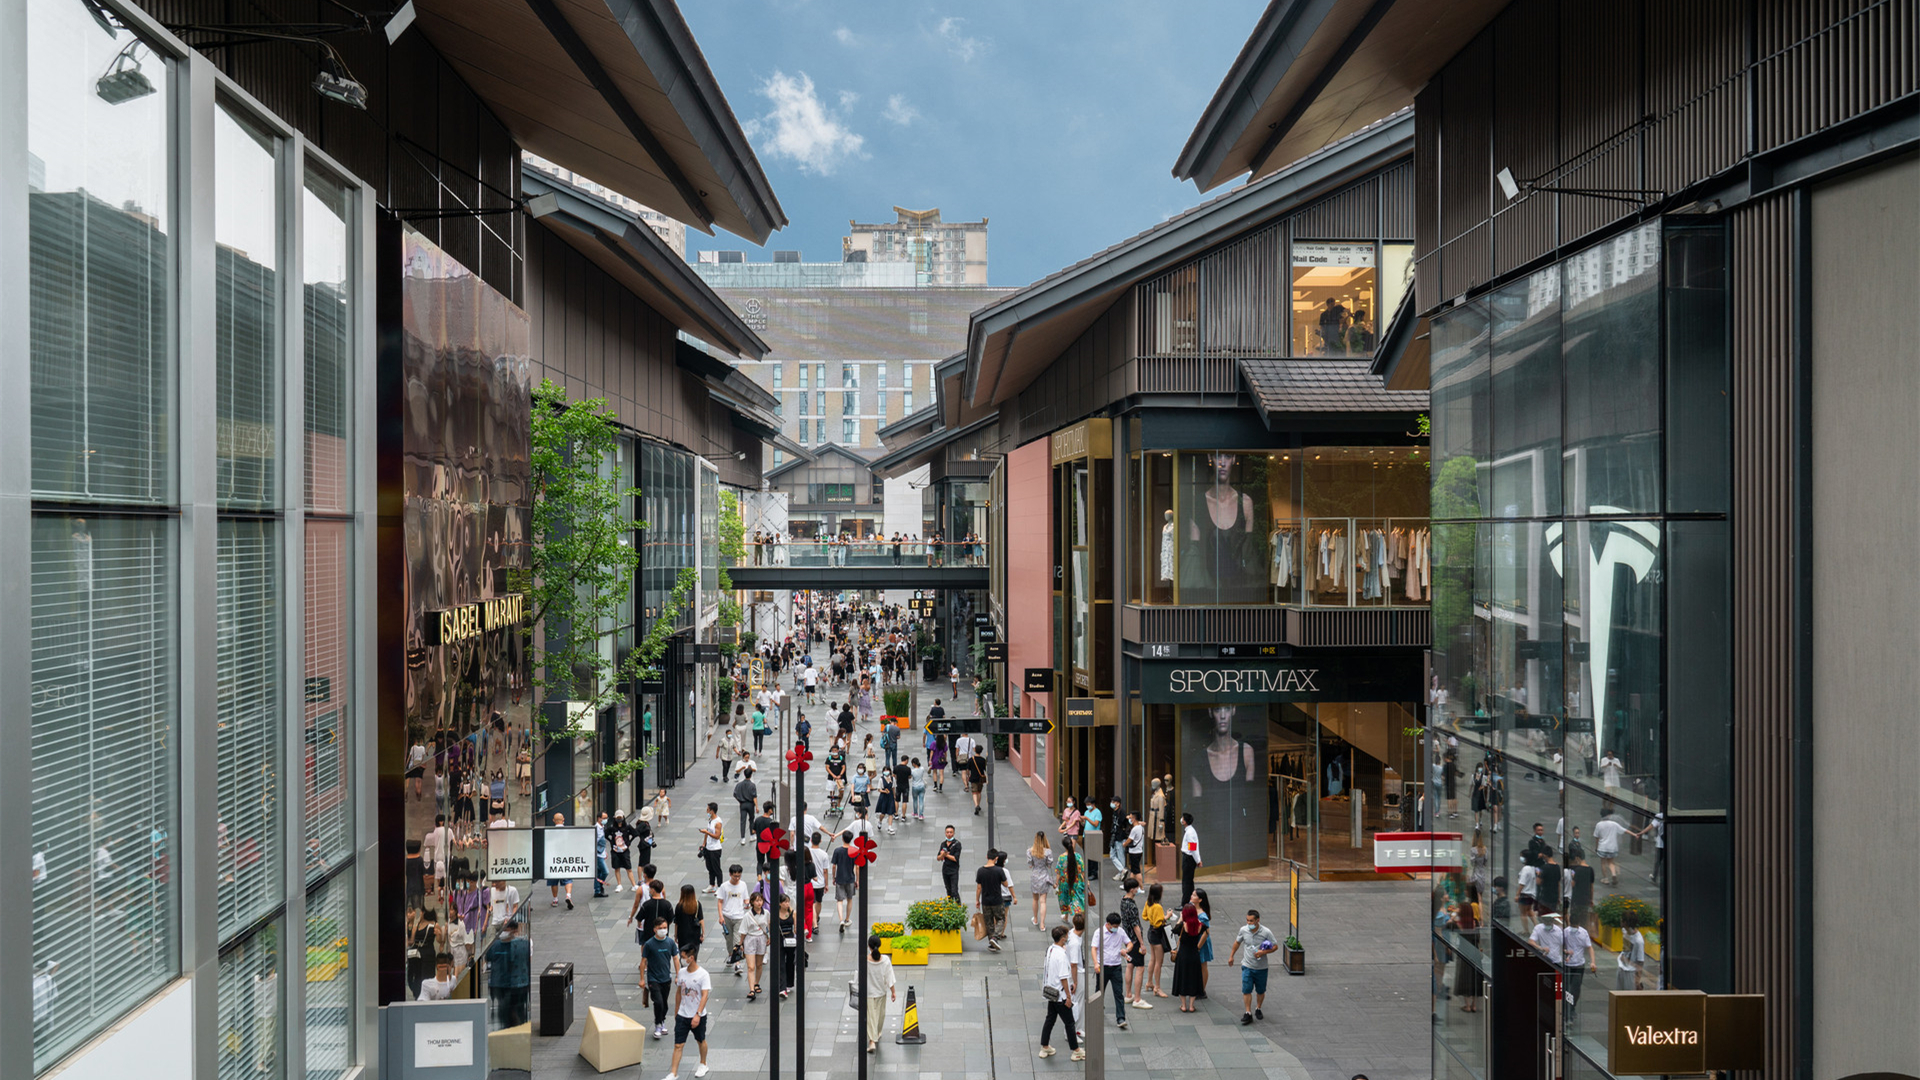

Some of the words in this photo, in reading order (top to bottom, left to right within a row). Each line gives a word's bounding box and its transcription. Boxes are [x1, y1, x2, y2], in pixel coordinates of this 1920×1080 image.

[1309, 255, 1328, 263] Code
[441, 604, 482, 645] ISABEL
[485, 595, 523, 632] MARANT
[1170, 669, 1320, 693] SPORTMAX
[553, 856, 586, 864] ISABEL
[1624, 1025, 1698, 1045] Valextra
